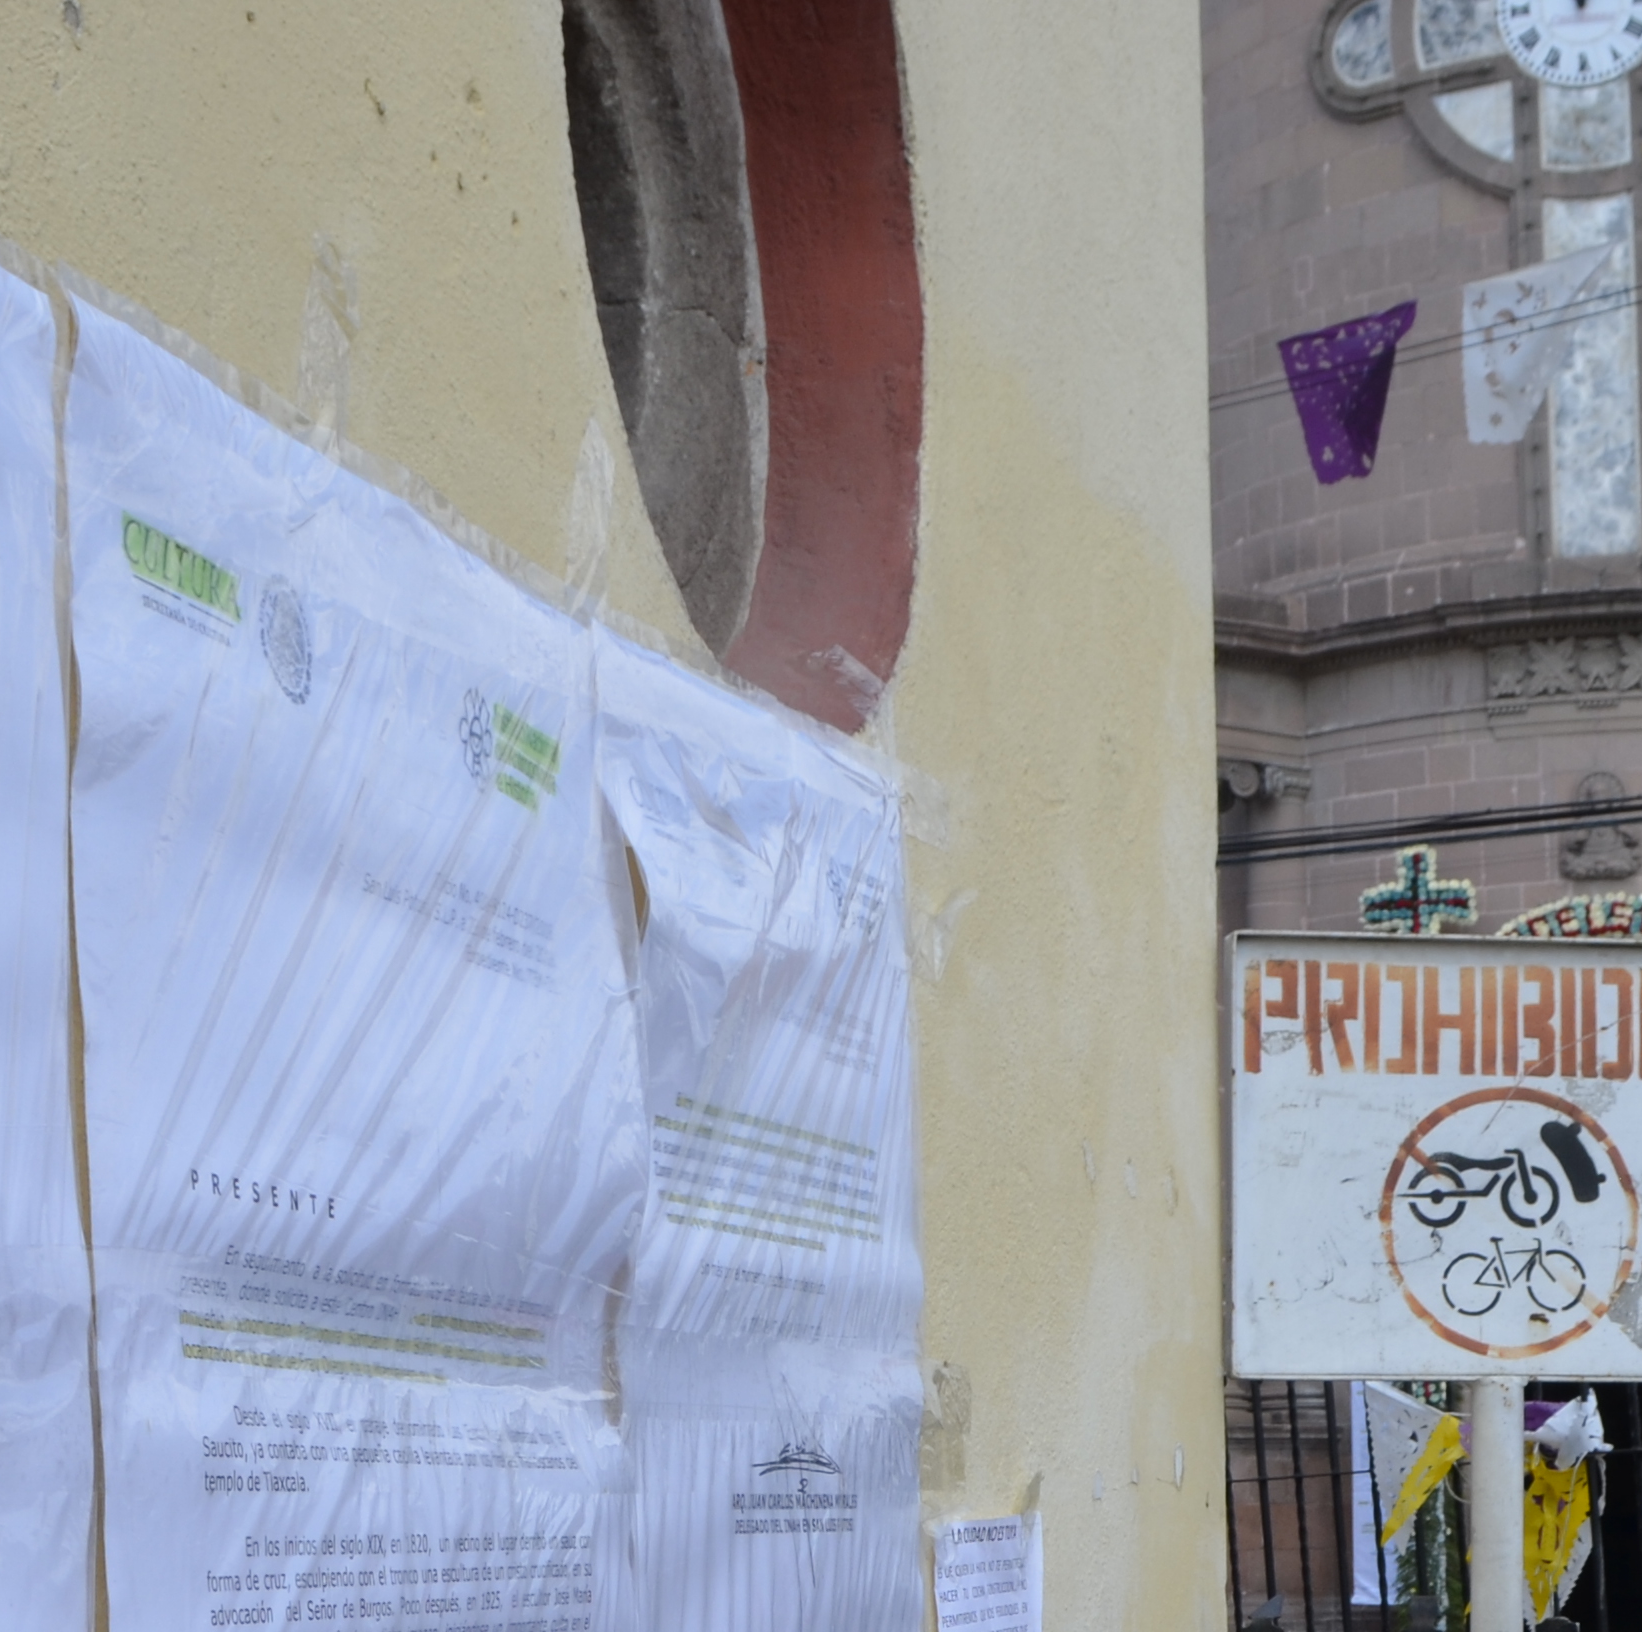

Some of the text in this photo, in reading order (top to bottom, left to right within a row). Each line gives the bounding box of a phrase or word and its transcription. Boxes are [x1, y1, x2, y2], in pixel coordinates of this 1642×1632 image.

[123, 519, 241, 622] CULTURA
[204, 1470, 309, 1496] templo de Tlaxcala.
[245, 1536, 259, 1557] En
[265, 1536, 280, 1556] los
[284, 1536, 317, 1556] inicios
[321, 1535, 336, 1555] del
[341, 1535, 363, 1560] siglo
[207, 1570, 241, 1592] forma
[246, 1569, 259, 1591] de
[264, 1572, 291, 1593] cruz,
[295, 1567, 354, 1592] esculpiendo
[359, 1570, 375, 1586] con
[379, 1566, 387, 1585] el
[210, 1600, 273, 1626] advocación
[286, 1600, 302, 1622] del
[307, 1599, 337, 1621] Señor
[343, 1598, 354, 1619] de
